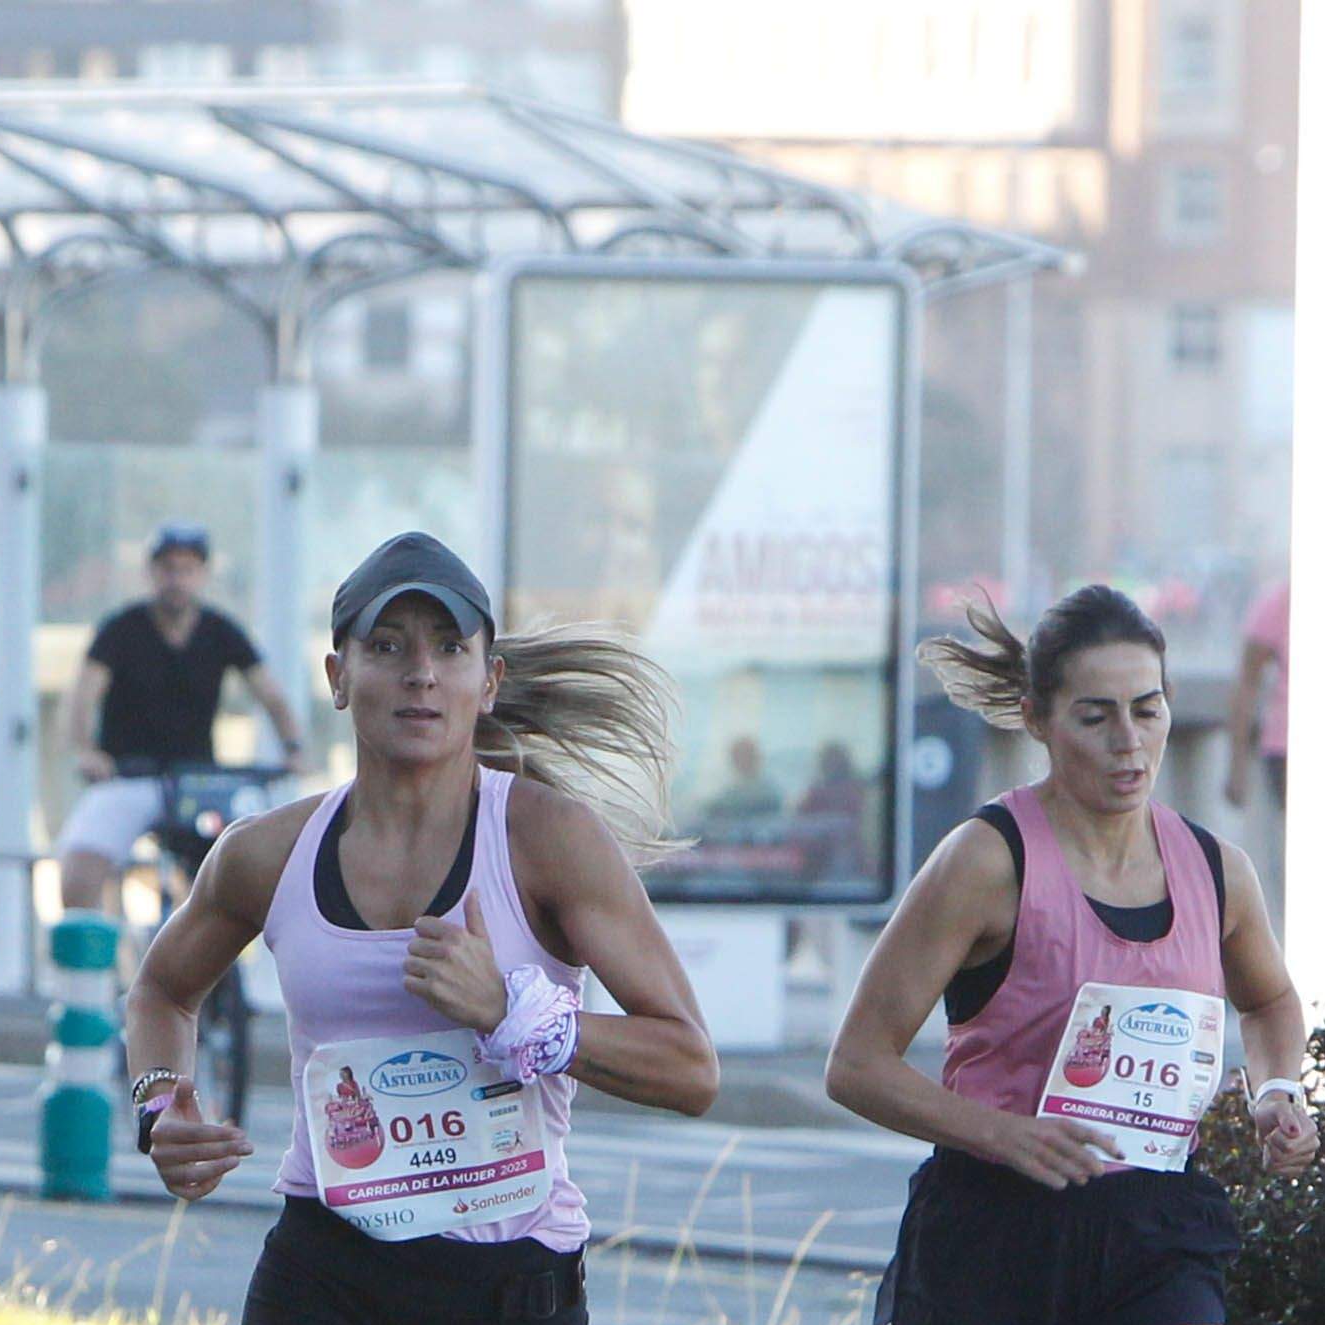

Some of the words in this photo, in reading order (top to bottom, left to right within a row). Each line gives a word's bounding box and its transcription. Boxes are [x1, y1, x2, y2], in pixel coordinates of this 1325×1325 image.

[699, 529, 881, 594] AMIGOS
[378, 1065, 461, 1089] ASTURIANA
[1115, 1055, 1181, 1087] 016
[1134, 1091, 1153, 1108] 15
[389, 1110, 465, 1143] 016
[1061, 1102, 1114, 1120] CARRERA
[1116, 1112, 1132, 1123] DE
[1134, 1115, 1149, 1127] LA
[410, 1147, 457, 1169] 4449
[347, 1181, 409, 1200] CARRERA
[411, 1177, 430, 1190] DE
[432, 1174, 450, 1187] LA
[452, 1168, 496, 1184] MUJER
[500, 1159, 527, 1176] 2023
[469, 1183, 536, 1212] Santander
